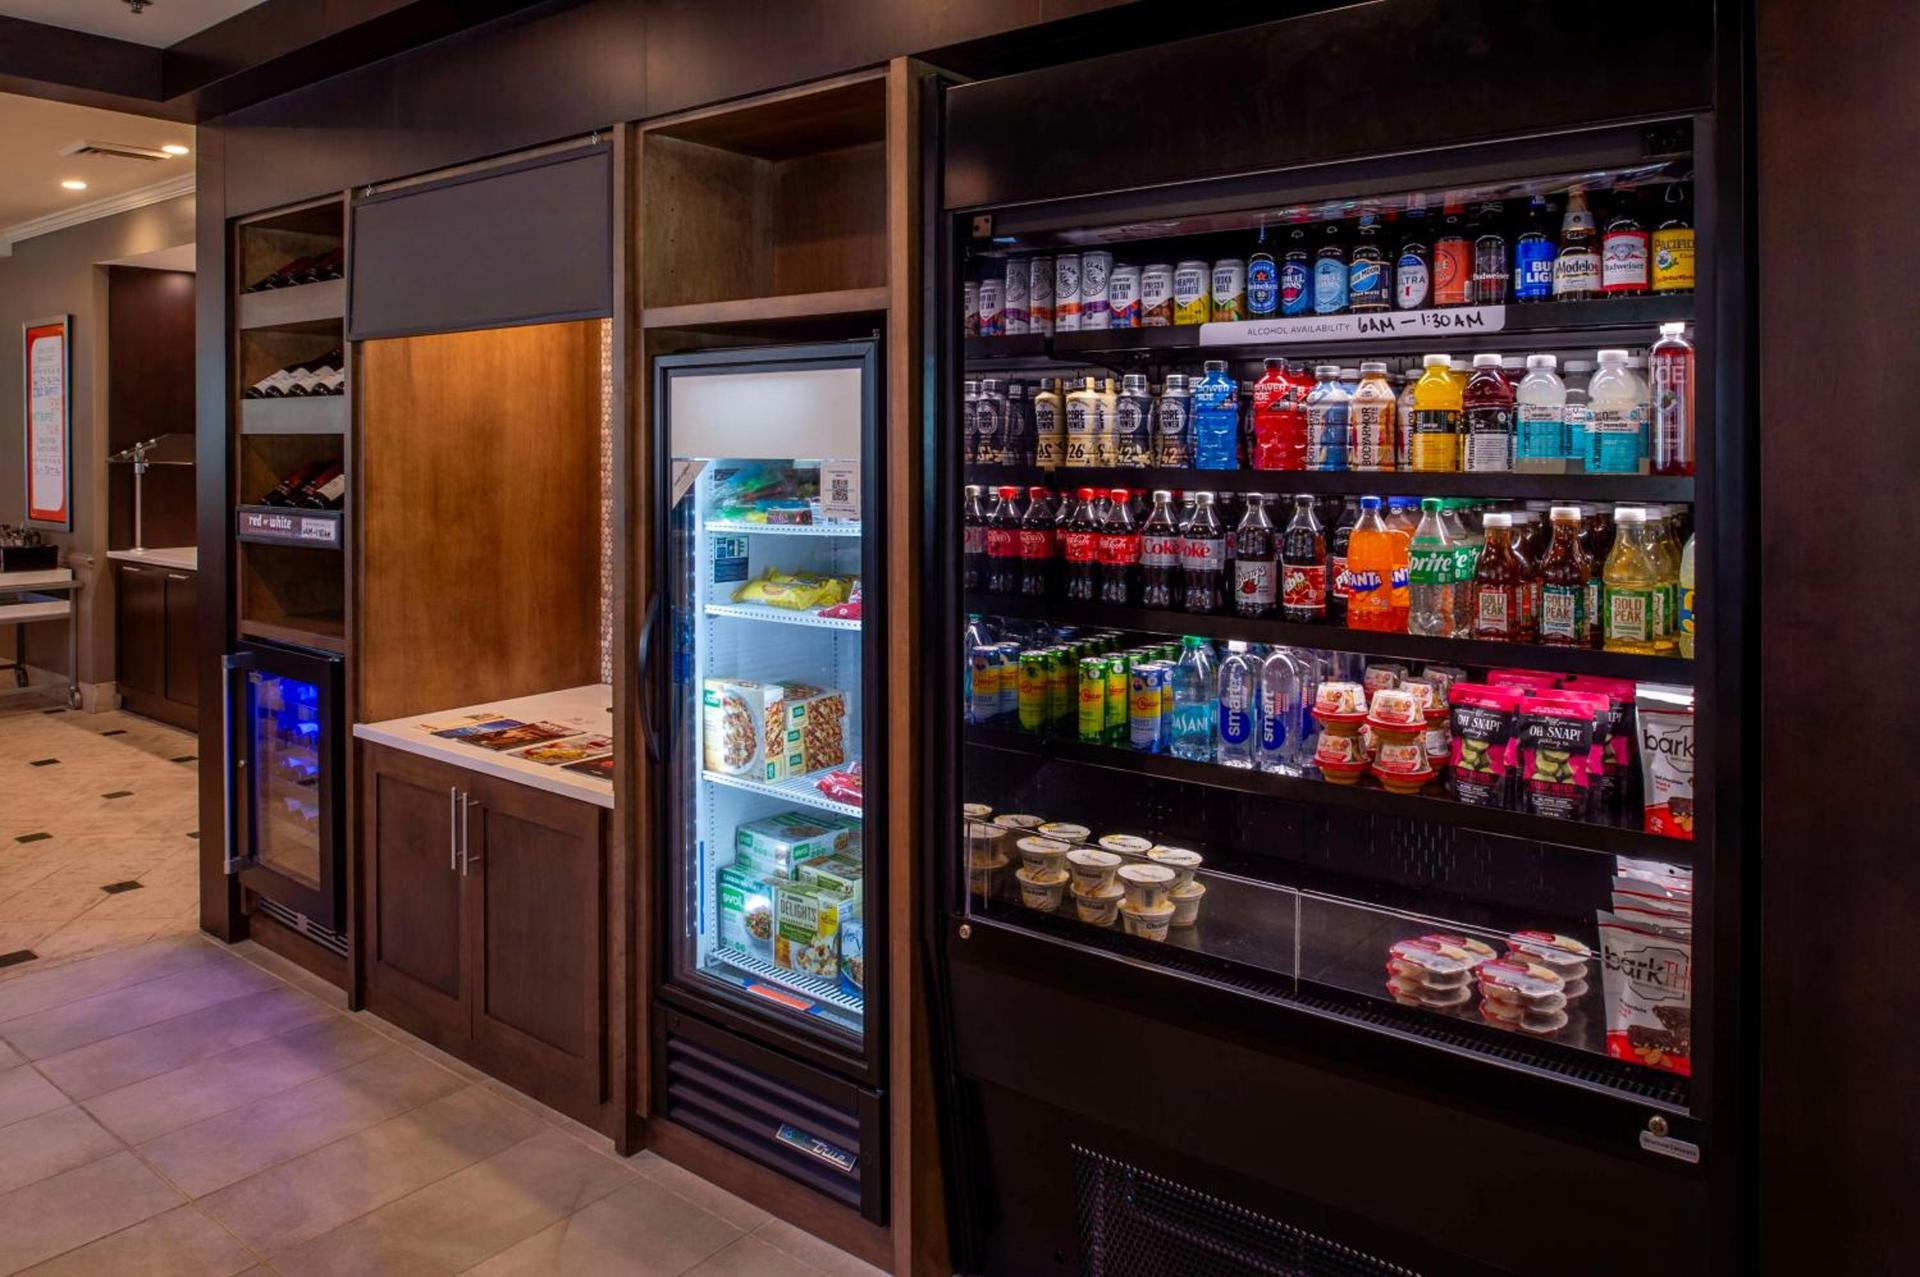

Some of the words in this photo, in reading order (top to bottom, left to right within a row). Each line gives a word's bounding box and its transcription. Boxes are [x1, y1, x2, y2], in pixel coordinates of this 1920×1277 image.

[1086, 261, 1104, 273] CLAW
[1361, 265, 1380, 277] MOON
[1532, 260, 1553, 271] BU
[1605, 262, 1644, 271] Budweiser
[1526, 272, 1553, 283] LIG
[1247, 328, 1288, 336] ALCOHOL
[1290, 324, 1350, 334] AVAILABILITY
[1357, 317, 1395, 333] 6AM
[1161, 409, 1179, 420] CORE
[1361, 407, 1372, 466] BODYARMOR
[249, 514, 262, 528] red
[269, 515, 293, 530] white
[1144, 539, 1181, 556] Coke
[1182, 541, 1211, 559] oke
[1410, 552, 1453, 574] prite
[1350, 571, 1382, 588] ANTA
[1481, 594, 1504, 605] GOLD
[1545, 595, 1571, 608] GOLD
[1614, 597, 1642, 610] GOLD
[1481, 604, 1504, 616] PEAK
[1545, 606, 1571, 619] PEAK
[1614, 610, 1642, 624] PEAK
[1173, 712, 1208, 732] ASANI
[1457, 714, 1469, 726] OH
[1471, 716, 1502, 732] SNAP!
[1529, 725, 1543, 736] OH
[1547, 726, 1582, 741] SNAP!
[780, 898, 817, 922] DELIGHTS
[811, 1138, 846, 1161] True
